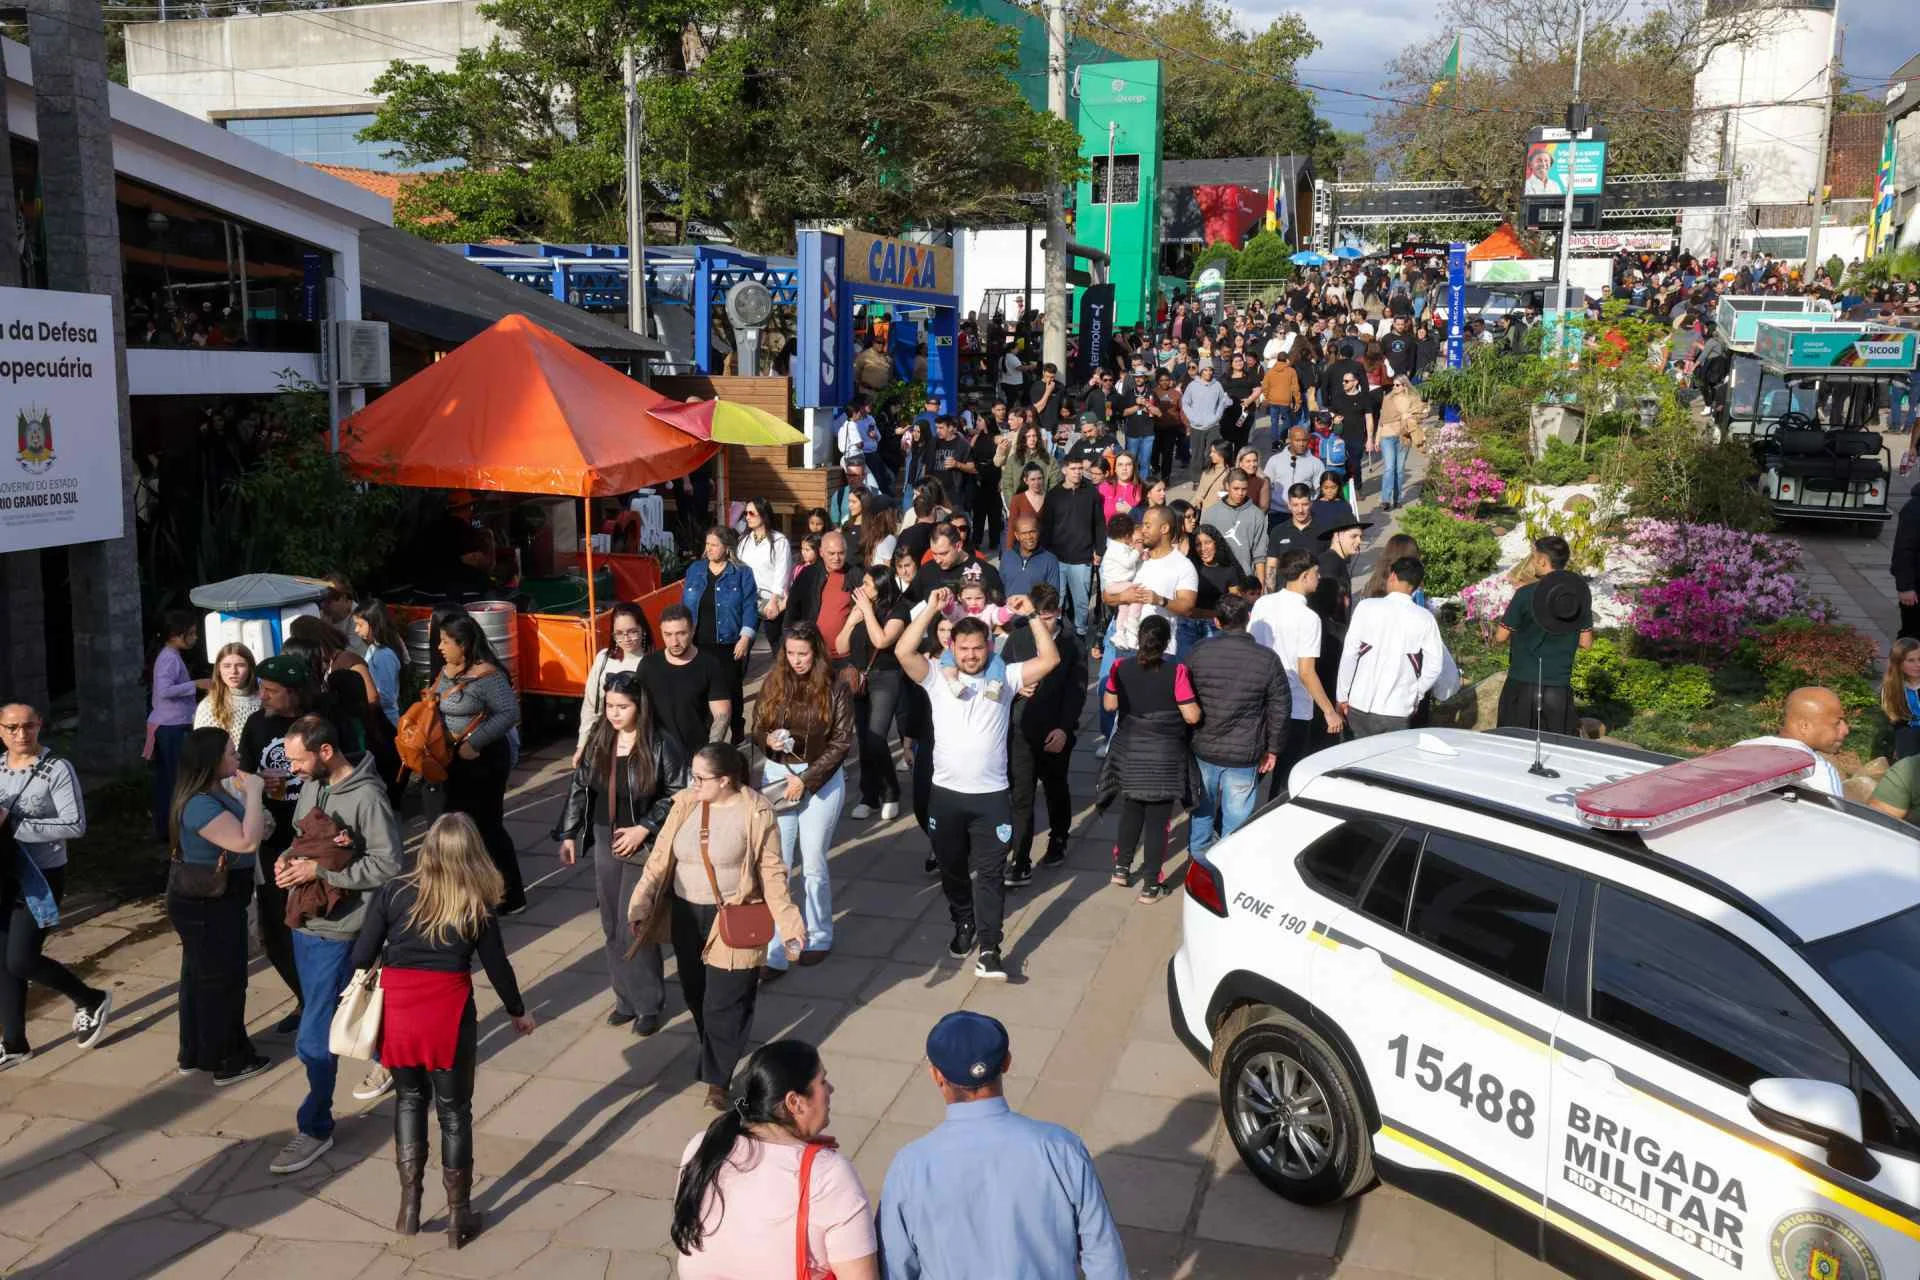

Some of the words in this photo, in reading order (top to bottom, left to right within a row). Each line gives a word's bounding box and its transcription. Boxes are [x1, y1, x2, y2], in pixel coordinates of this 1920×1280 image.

[868, 239, 936, 289] CAIXA
[9, 320, 34, 341] da
[38, 321, 97, 344] Defesa
[822, 256, 837, 386] CAIXA
[1089, 318, 1101, 367] termolar
[1868, 346, 1900, 355] SICOOB
[14, 494, 48, 509] GRANDE
[50, 493, 62, 505] DO
[63, 491, 79, 504] SUL
[36, 480, 48, 490] DO
[49, 478, 78, 490] ESTADO
[1233, 891, 1274, 919] FONE
[1279, 912, 1307, 935] 190
[1388, 1033, 1536, 1140] 15488
[1567, 1101, 1748, 1213] BRIGADA
[1564, 1133, 1744, 1249] MILITAR
[1568, 1168, 1597, 1193] RIO
[1600, 1186, 1668, 1233] GRANDE
[1671, 1219, 1697, 1245] DO
[1700, 1234, 1737, 1266] SUL
[1777, 1213, 1834, 1235] BRIGADA
